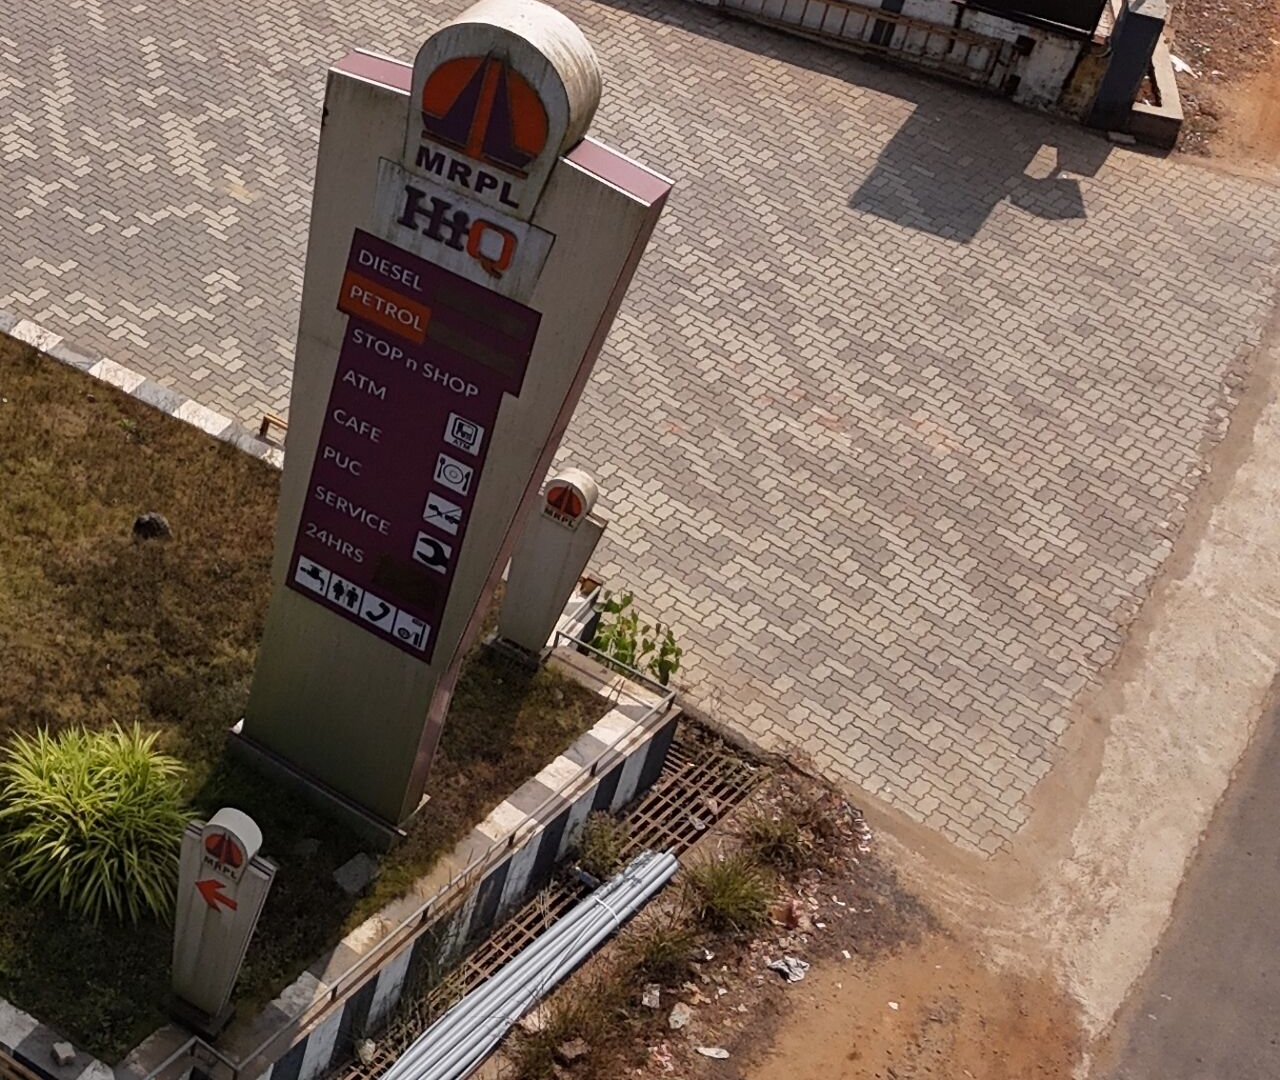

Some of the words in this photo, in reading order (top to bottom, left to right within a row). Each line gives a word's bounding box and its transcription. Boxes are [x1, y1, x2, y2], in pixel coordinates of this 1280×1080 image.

[415, 145, 519, 209] MRPL
[397, 184, 518, 280] HiQ
[358, 249, 423, 292] DIESEL
[350, 285, 423, 332] PETROL
[352, 328, 403, 360] STOP
[406, 358, 418, 371] n
[422, 363, 479, 397] SHOP
[342, 370, 387, 400] ATM
[333, 409, 383, 443] CAFE
[452, 438, 471, 451] ATM
[323, 446, 362, 476] PUC
[314, 485, 391, 535] SERVICE
[544, 507, 574, 529] MRPL
[305, 522, 365, 563] 24HRS
[204, 855, 237, 880] MRPL
